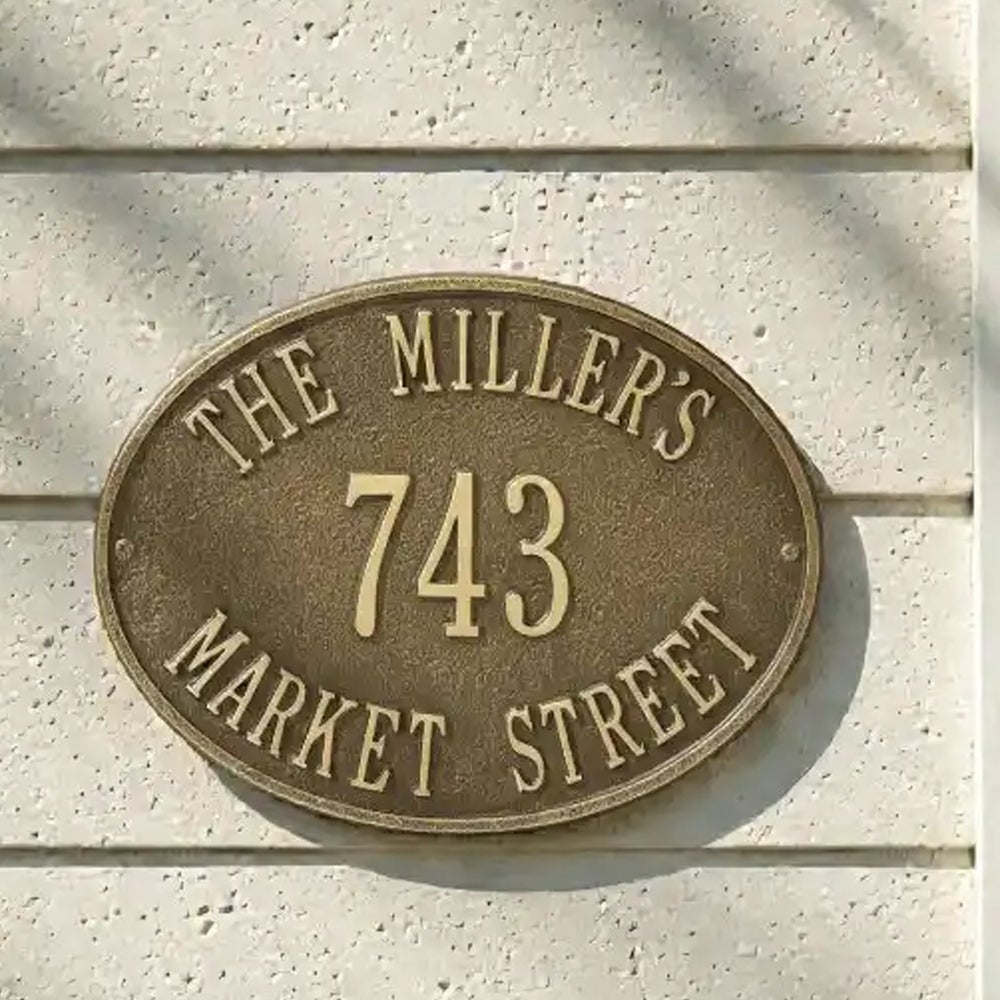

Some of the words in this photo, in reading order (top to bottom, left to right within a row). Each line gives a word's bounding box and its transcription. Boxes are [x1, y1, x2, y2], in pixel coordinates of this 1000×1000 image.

[183, 338, 340, 474] THE
[385, 309, 716, 461] MILLER'S
[345, 472, 570, 638] 743
[163, 608, 446, 797] MARKET
[506, 599, 757, 794] STREET
